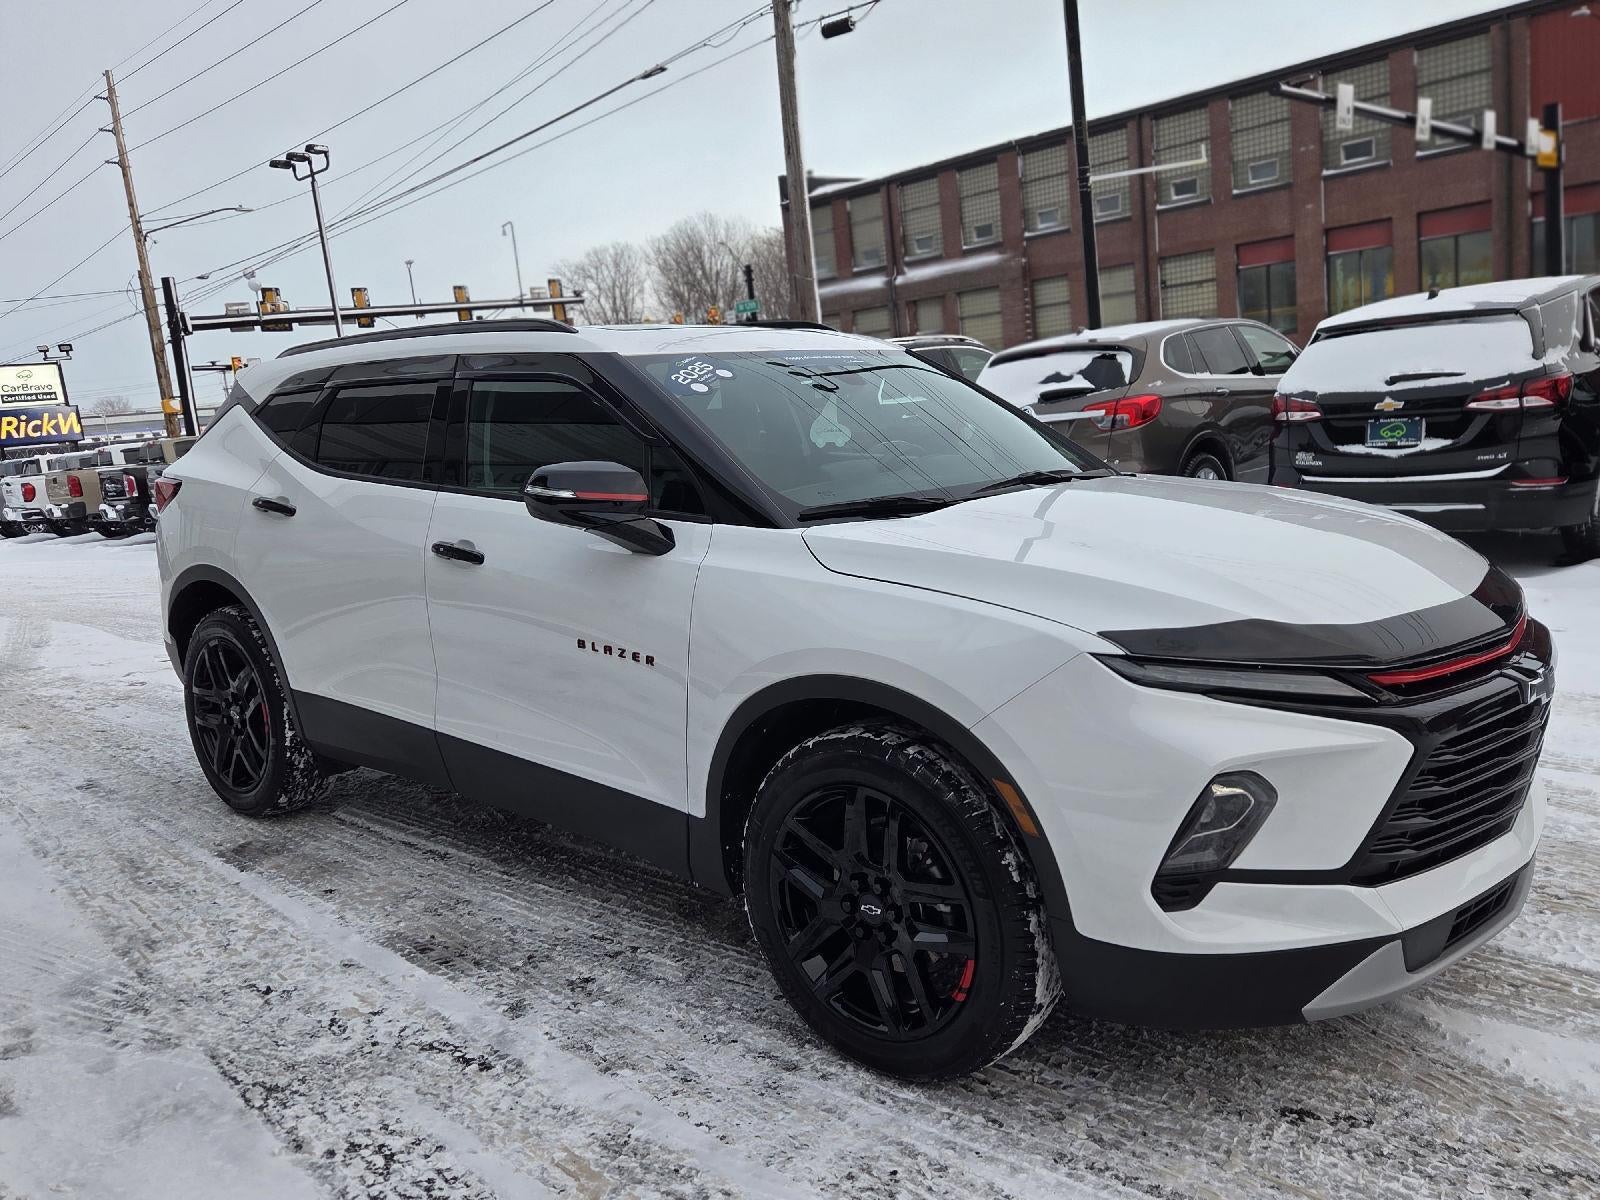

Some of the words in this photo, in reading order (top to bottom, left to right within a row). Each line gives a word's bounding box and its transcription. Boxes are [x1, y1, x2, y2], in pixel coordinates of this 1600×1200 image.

[671, 361, 713, 384] 2025
[1, 383, 53, 392] CarBravo
[577, 638, 655, 667] BLAZER
